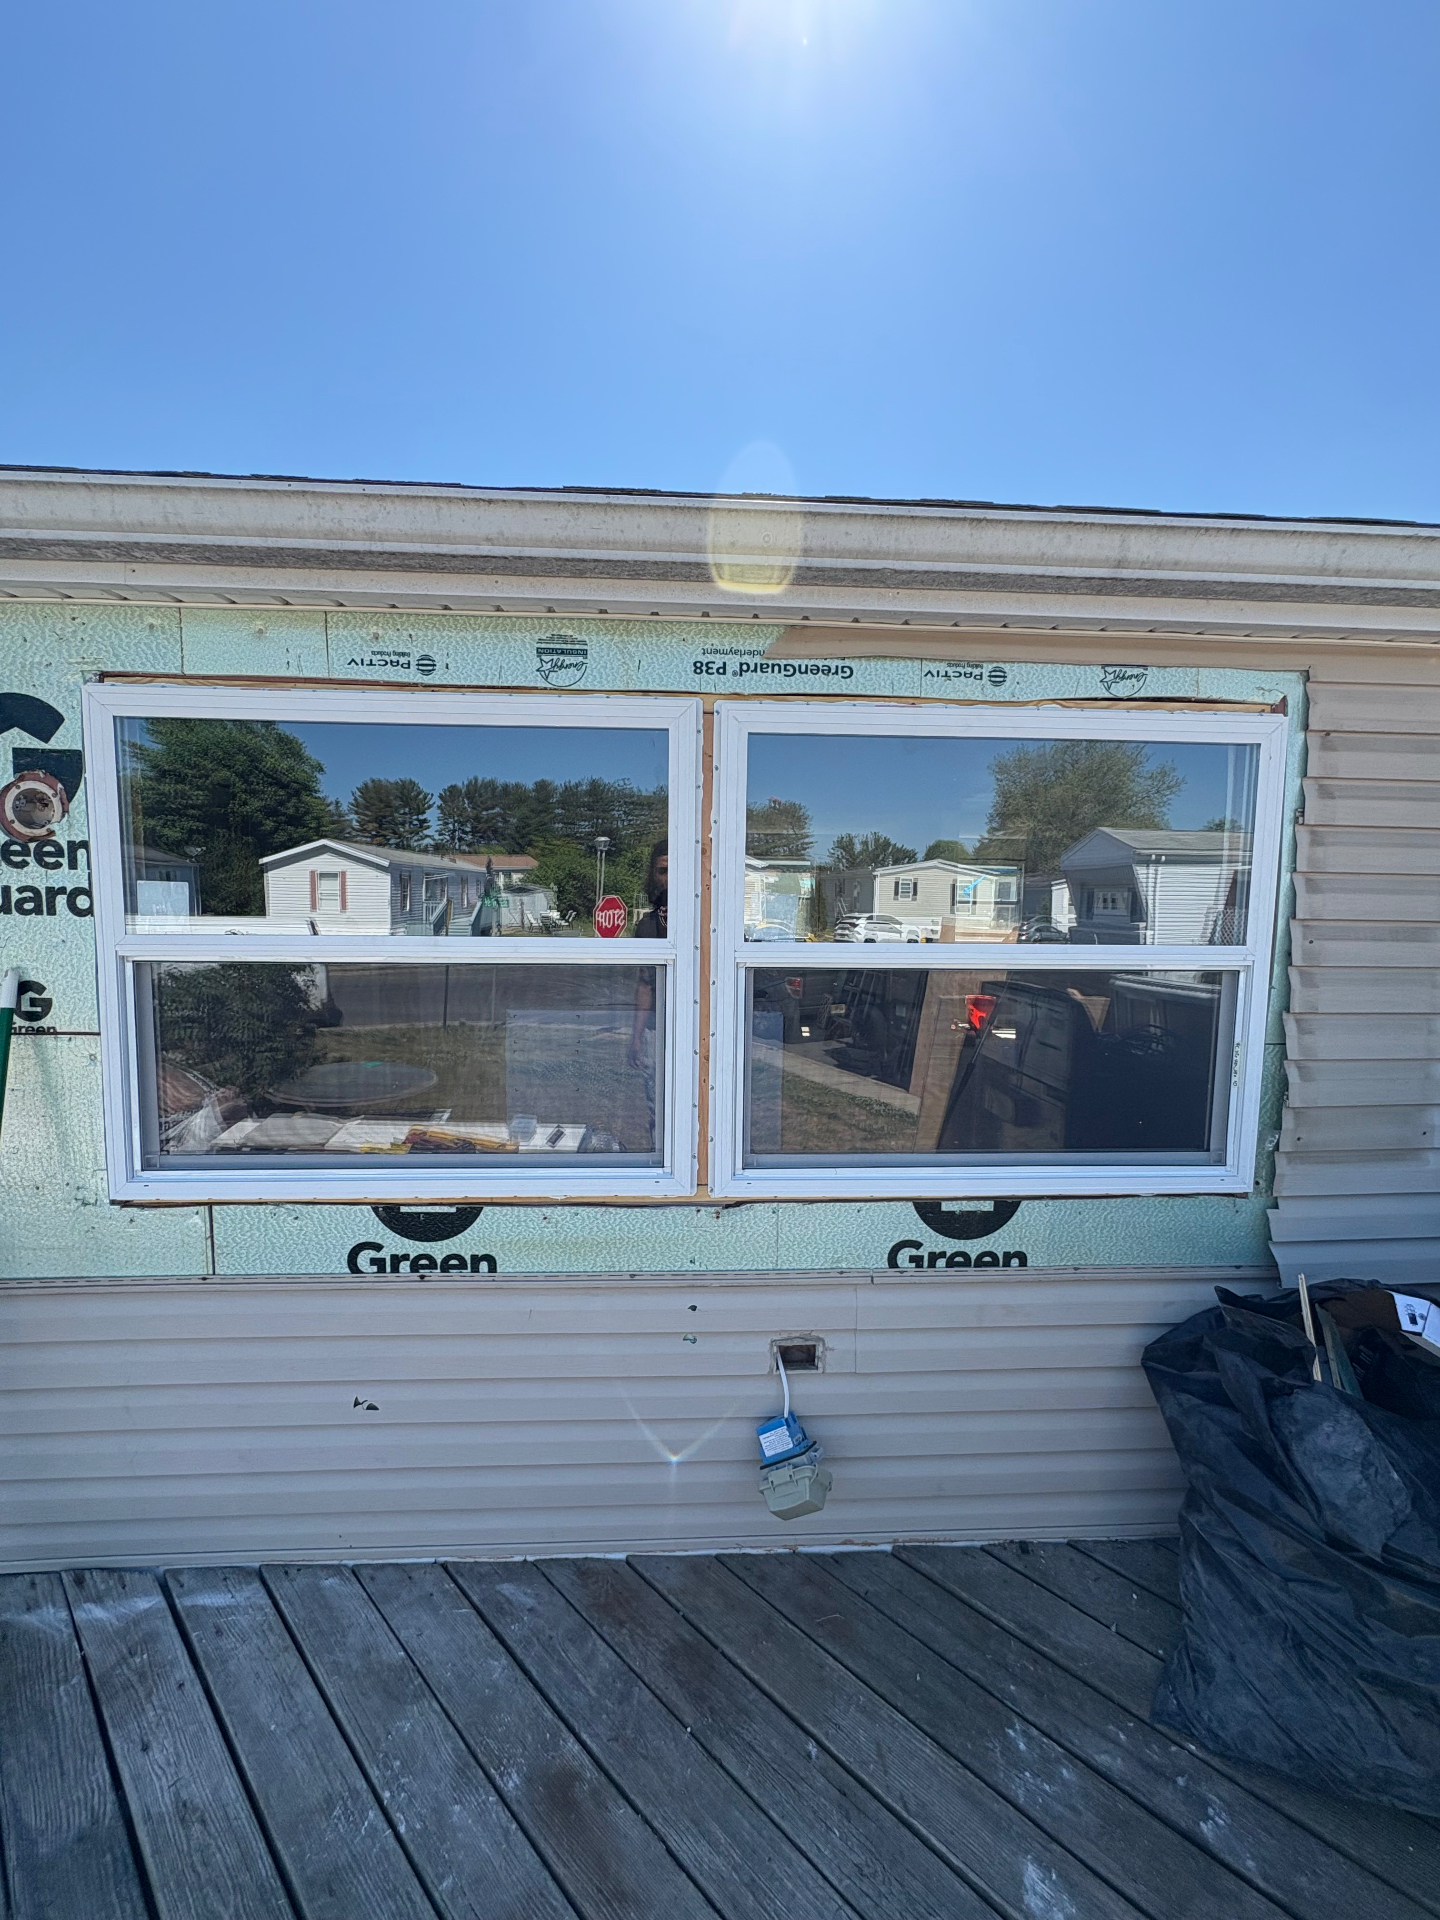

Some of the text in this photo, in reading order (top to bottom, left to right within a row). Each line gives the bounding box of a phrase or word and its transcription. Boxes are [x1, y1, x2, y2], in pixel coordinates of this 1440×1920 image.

[702, 648, 765, 657] nderlayment
[347, 658, 411, 669] PACTIV
[693, 661, 727, 676] P38
[924, 670, 983, 680] PACTIV
[347, 1241, 498, 1273] Green
[887, 1240, 1028, 1268] Green
